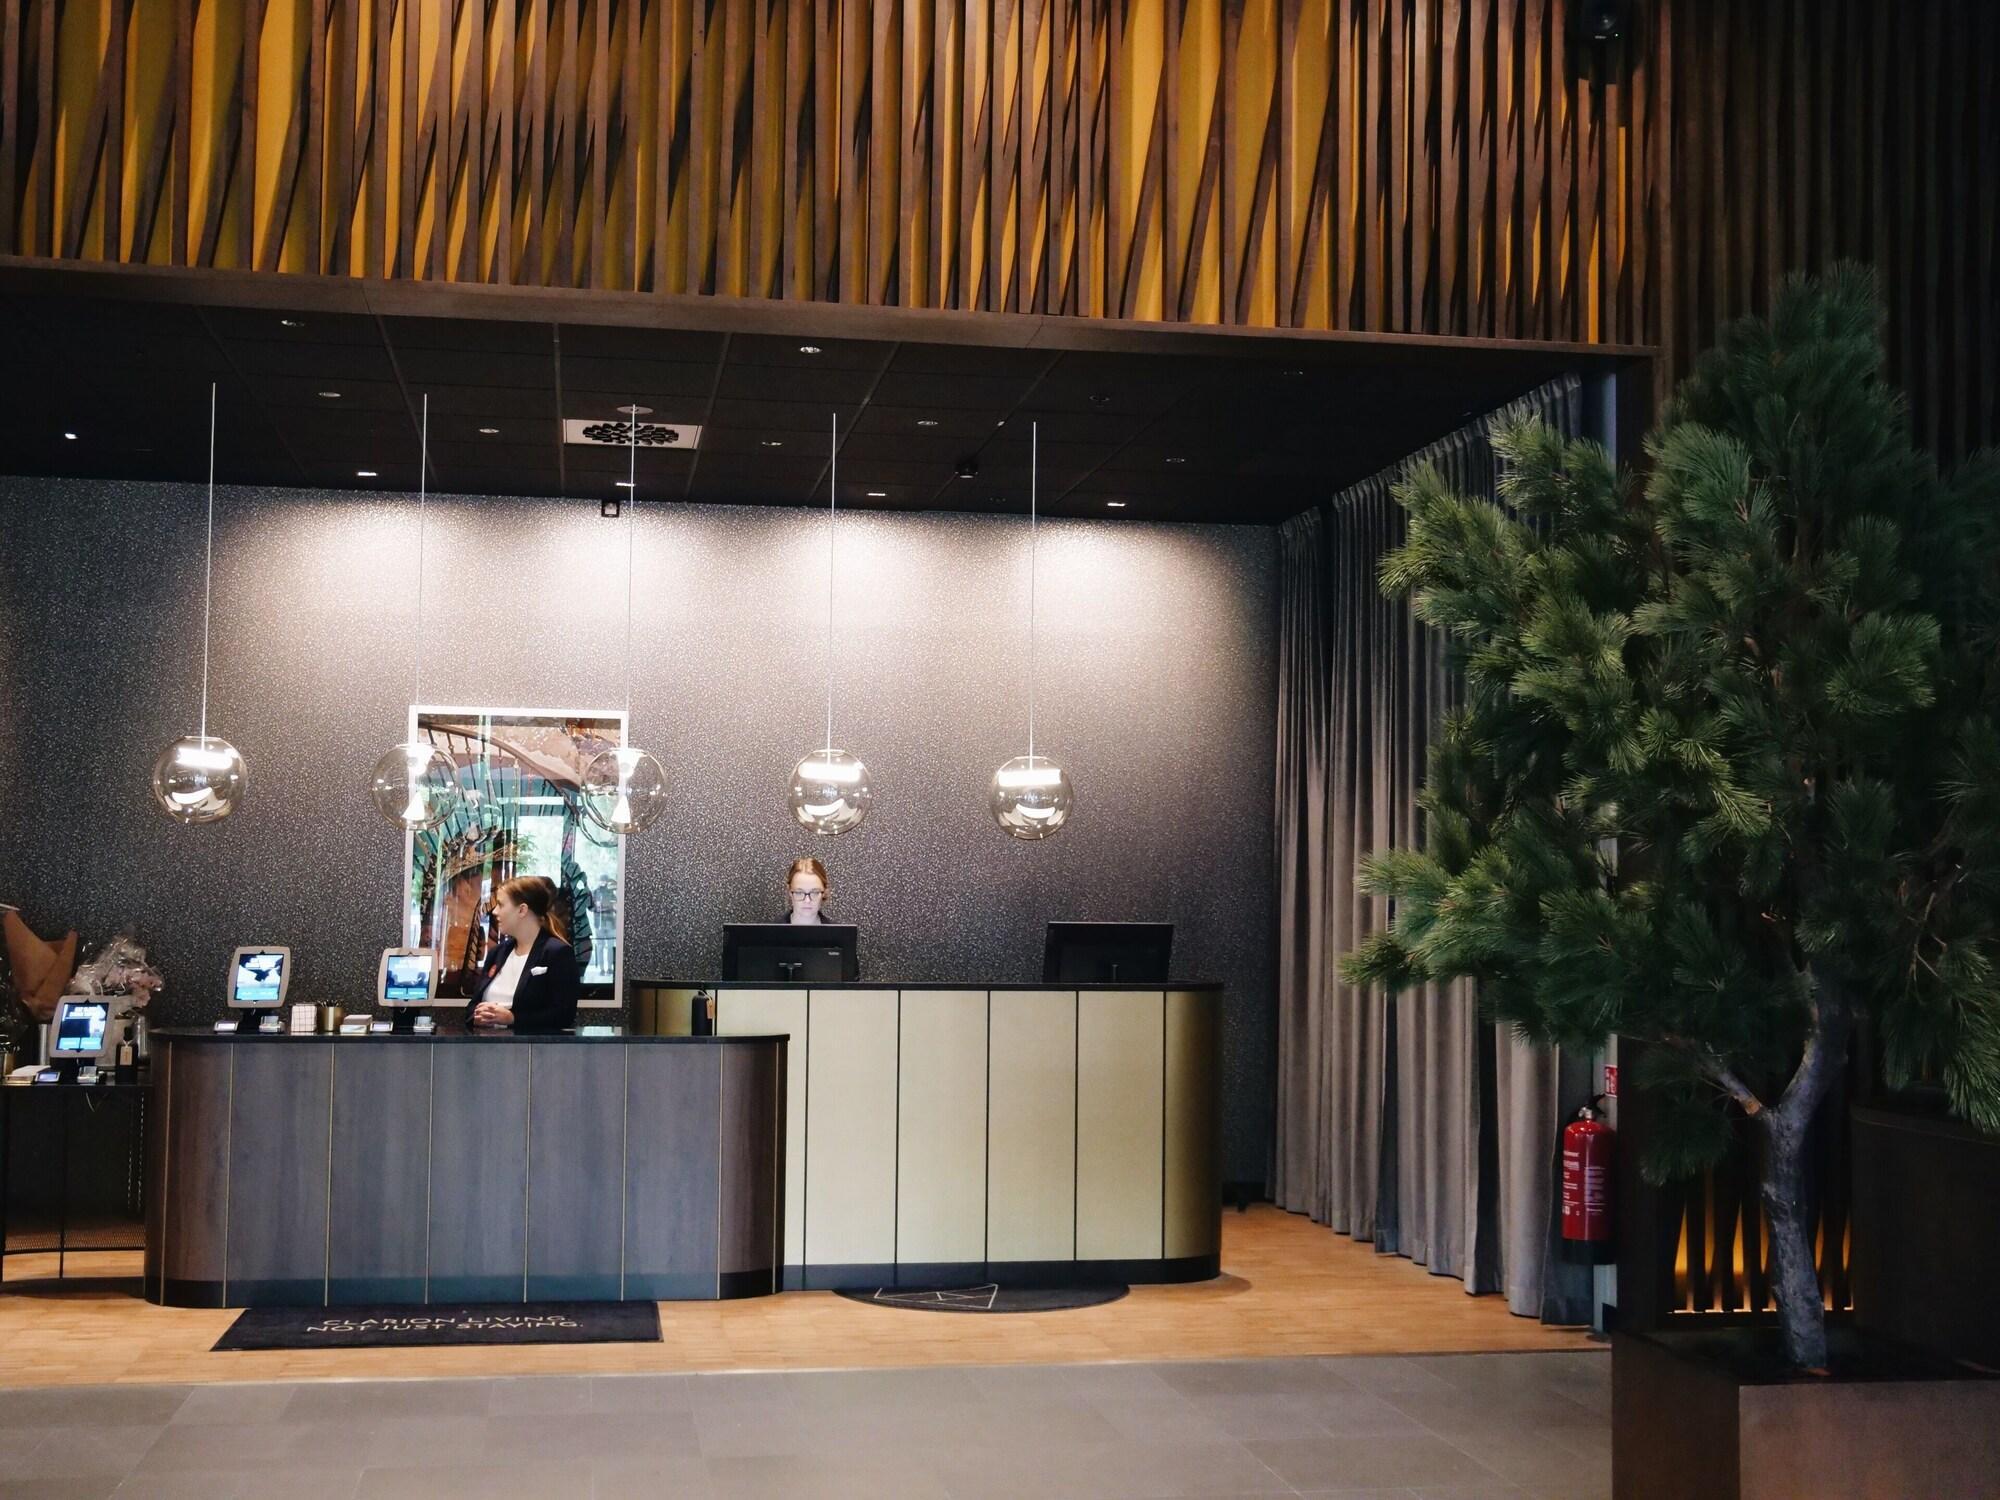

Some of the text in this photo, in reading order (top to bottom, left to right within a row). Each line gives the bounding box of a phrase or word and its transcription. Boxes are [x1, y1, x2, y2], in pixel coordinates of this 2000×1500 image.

[306, 1321, 584, 1332] NOT JUST STAYING.
[323, 1317, 456, 1326] CLARION
